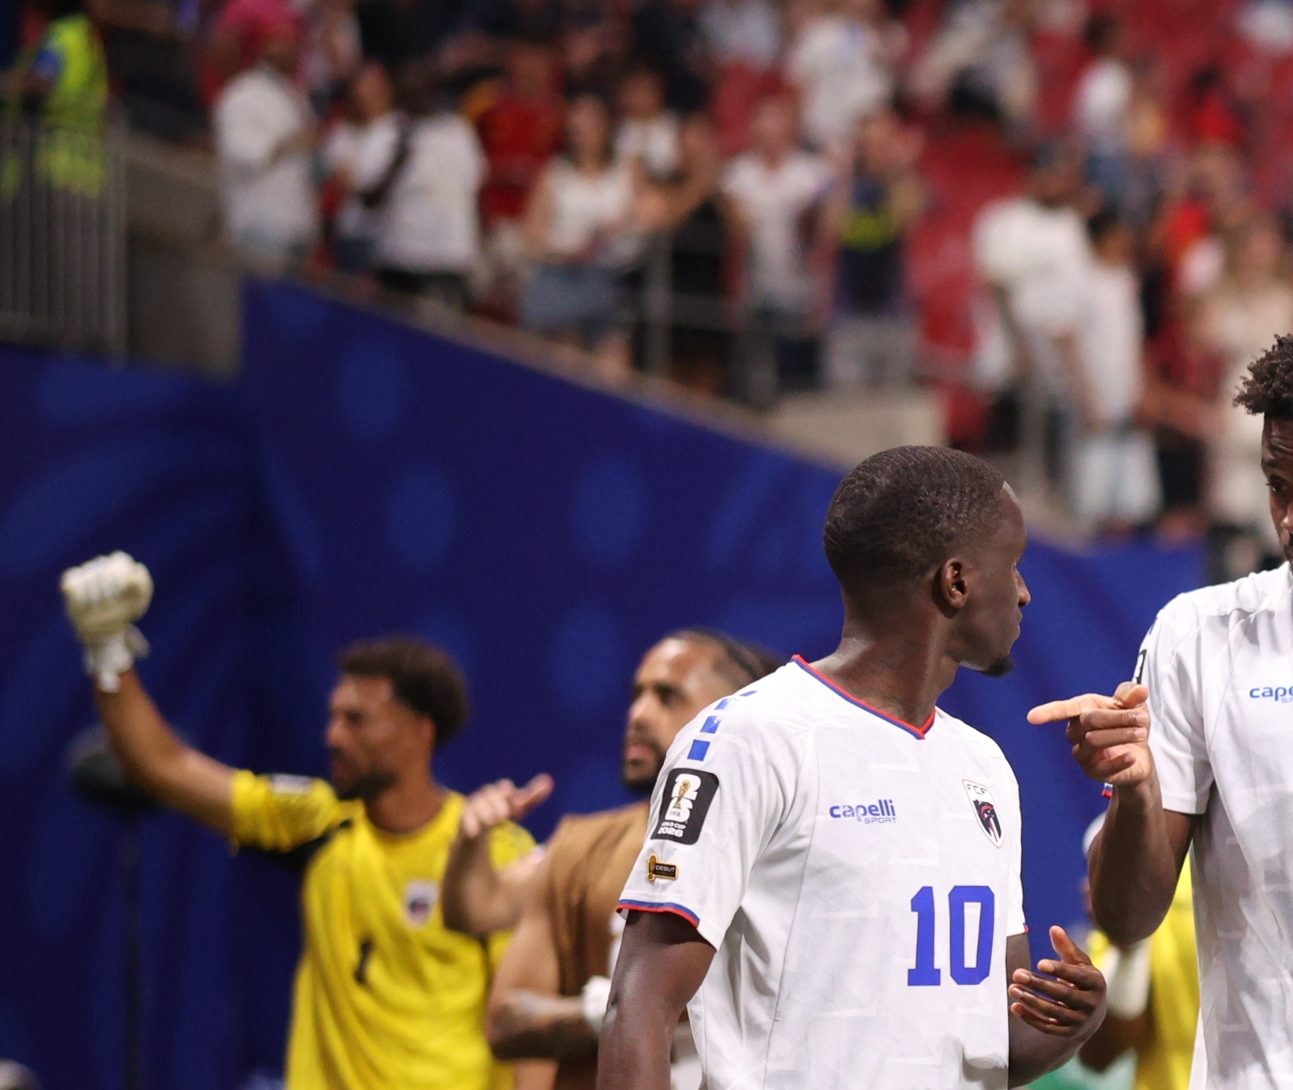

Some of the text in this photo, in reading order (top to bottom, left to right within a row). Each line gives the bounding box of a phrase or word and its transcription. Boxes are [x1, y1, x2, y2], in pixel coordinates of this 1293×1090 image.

[829, 799, 896, 822] capelli
[864, 817, 896, 825] SPORT
[655, 864, 676, 873] DEBUT
[907, 885, 995, 986] 10
